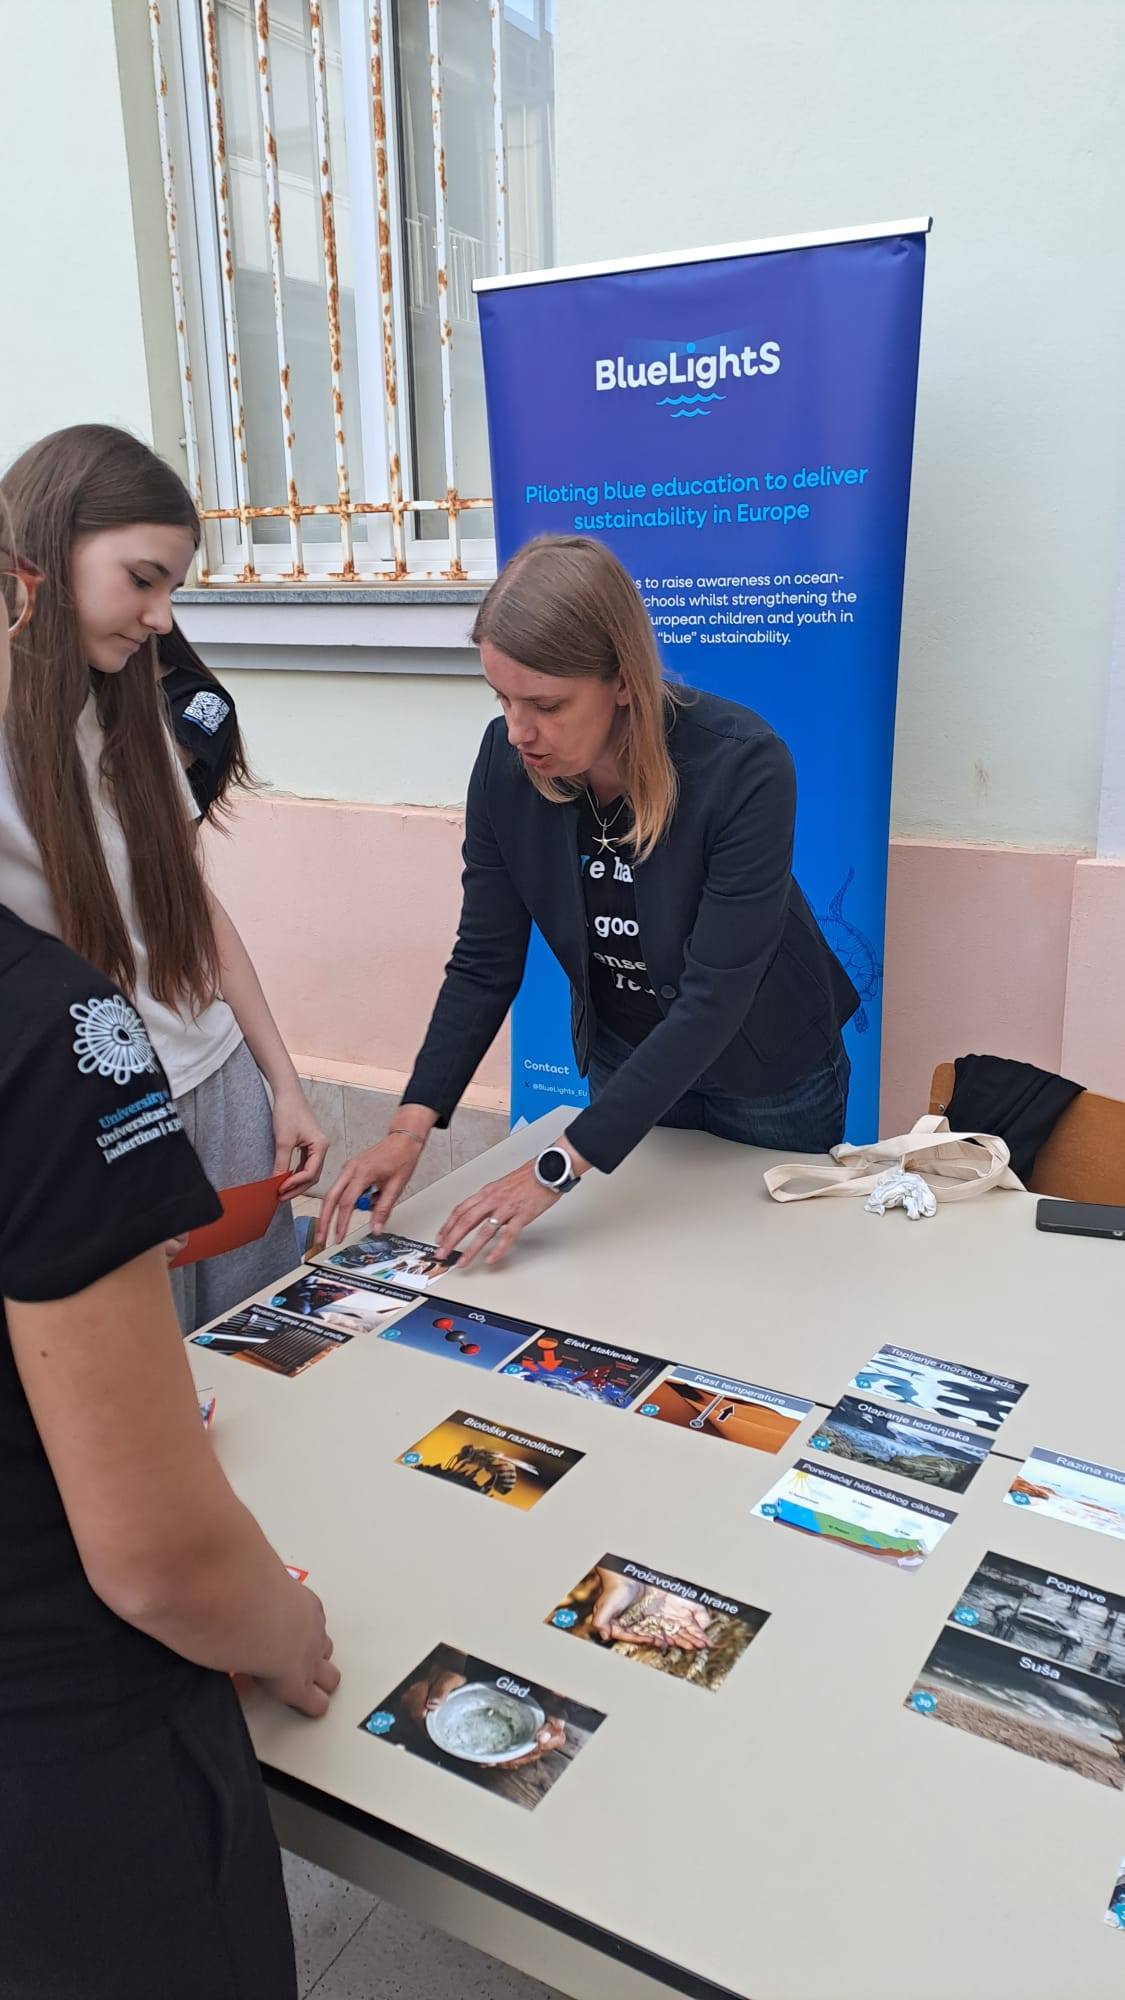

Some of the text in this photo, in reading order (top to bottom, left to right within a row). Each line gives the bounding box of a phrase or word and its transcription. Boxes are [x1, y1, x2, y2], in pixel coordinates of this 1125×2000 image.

[595, 341, 781, 391] BlueLightS
[525, 465, 869, 506] Piloting blue education to deliver
[574, 503, 810, 530] sustainability in Europe
[645, 577, 659, 589] to
[662, 575, 694, 588] raise
[696, 575, 771, 588] awareness
[774, 575, 791, 586] on
[794, 573, 845, 585] ocean-
[642, 589, 857, 608] chools whilst strengthening the
[647, 609, 854, 628] uropean children and youth in
[700, 630, 792, 646] sustainability.
[594, 915, 640, 938] goo
[523, 1059, 570, 1075] Contact
[96, 1107, 168, 1148] Universitas
[563, 1338, 591, 1351] Efekt
[694, 1374, 786, 1405] Rast temperature
[939, 1363, 988, 1383] morskog
[989, 1377, 1016, 1390] leda
[857, 1403, 970, 1442] Otapanje ledenjaka
[463, 1417, 565, 1457] Biološka raznolikost
[1056, 1456, 1102, 1476] Razina
[853, 1481, 909, 1507] hidrološkog
[910, 1501, 946, 1519] ciklusa
[623, 1563, 739, 1615] Proizvodnja hrane
[1045, 1575, 1107, 1605] Poplave
[1018, 1656, 1061, 1680] Suša
[495, 1676, 531, 1698] Glad
